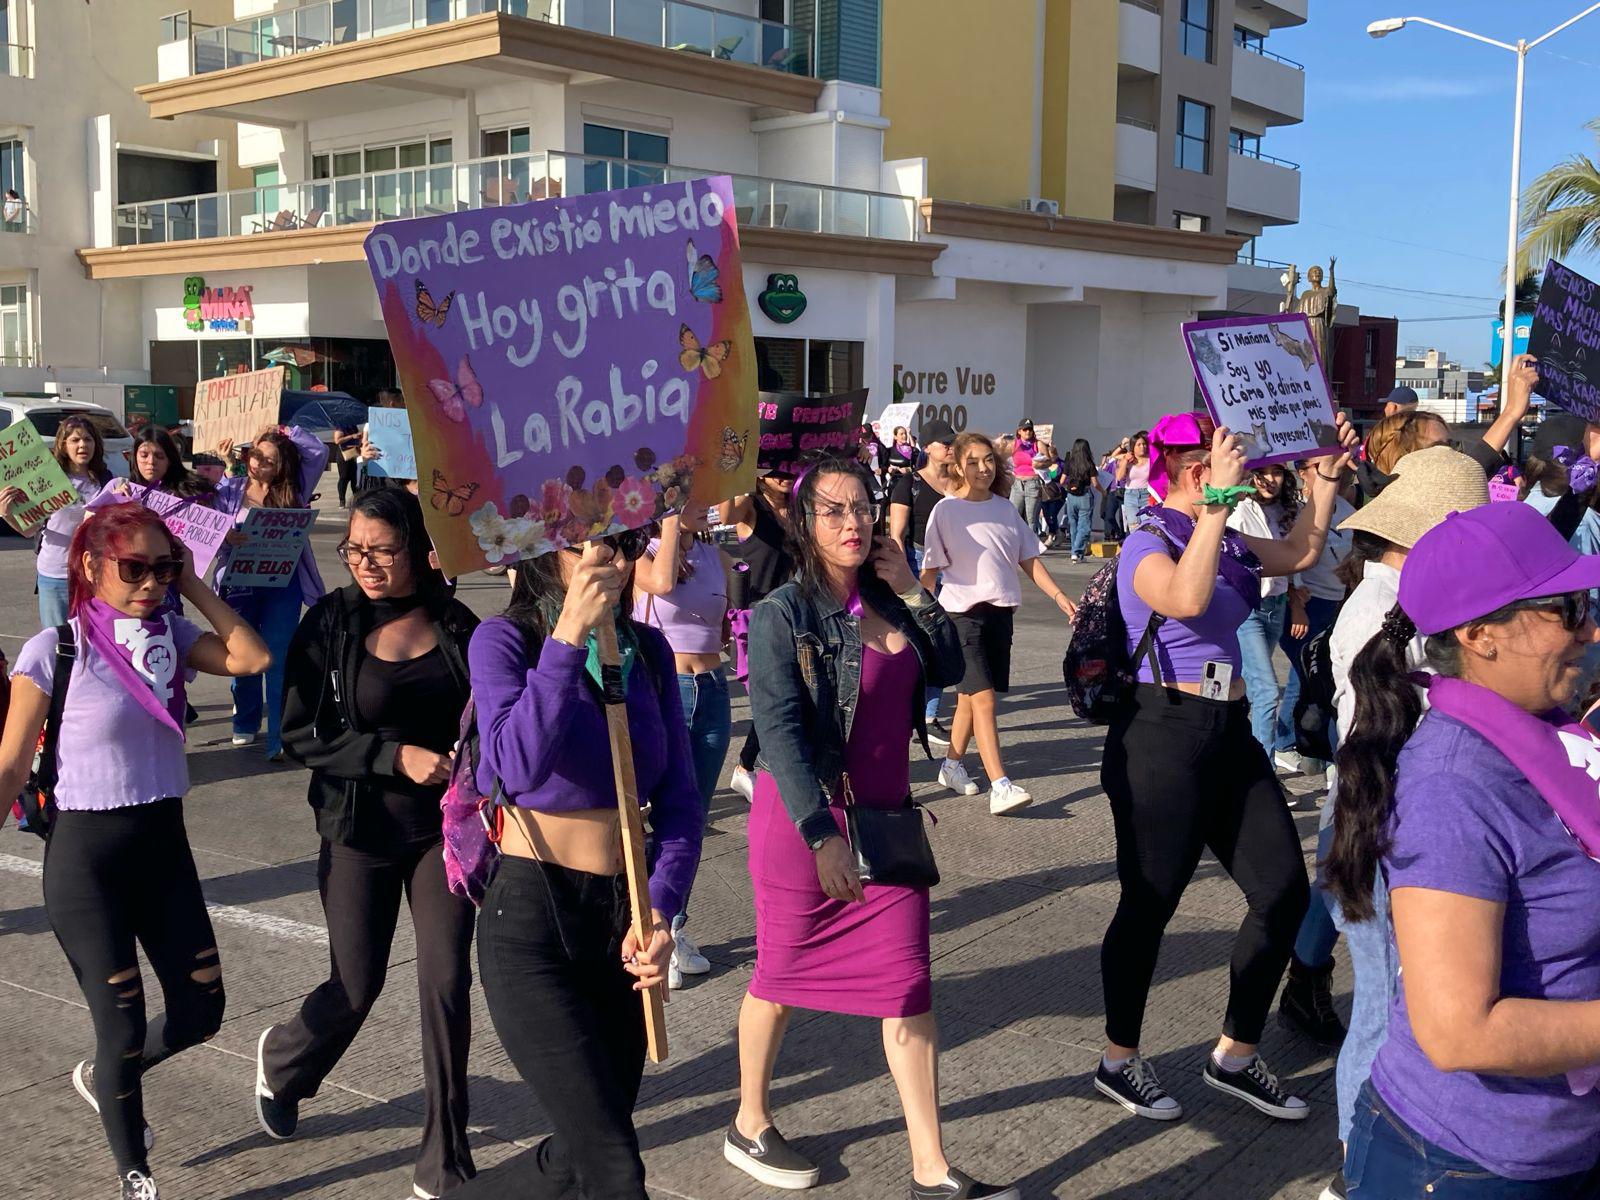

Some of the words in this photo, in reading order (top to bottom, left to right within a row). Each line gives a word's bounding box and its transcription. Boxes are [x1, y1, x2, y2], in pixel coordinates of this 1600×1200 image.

[370, 221, 486, 279] Donde
[1545, 260, 1595, 303] MENOS
[457, 291, 543, 368] Hoy
[552, 257, 677, 359] grita
[1535, 302, 1563, 332] MAS
[1217, 332, 1235, 352] Si
[1234, 332, 1271, 347] Mañana
[894, 364, 948, 394] Torre
[956, 366, 996, 395] Vue
[1227, 361, 1250, 382] Soy
[1303, 380, 1312, 392] a
[555, 359, 691, 449] Rabia
[917, 404, 968, 433] 1200
[1268, 399, 1289, 421] gatos
[1289, 402, 1301, 419] que
[18, 489, 75, 527] NINGUNA
[184, 524, 220, 547] PORQUE
[261, 528, 290, 540] HOY
[230, 560, 255, 575] POR
[255, 560, 295, 575] ELLAS
